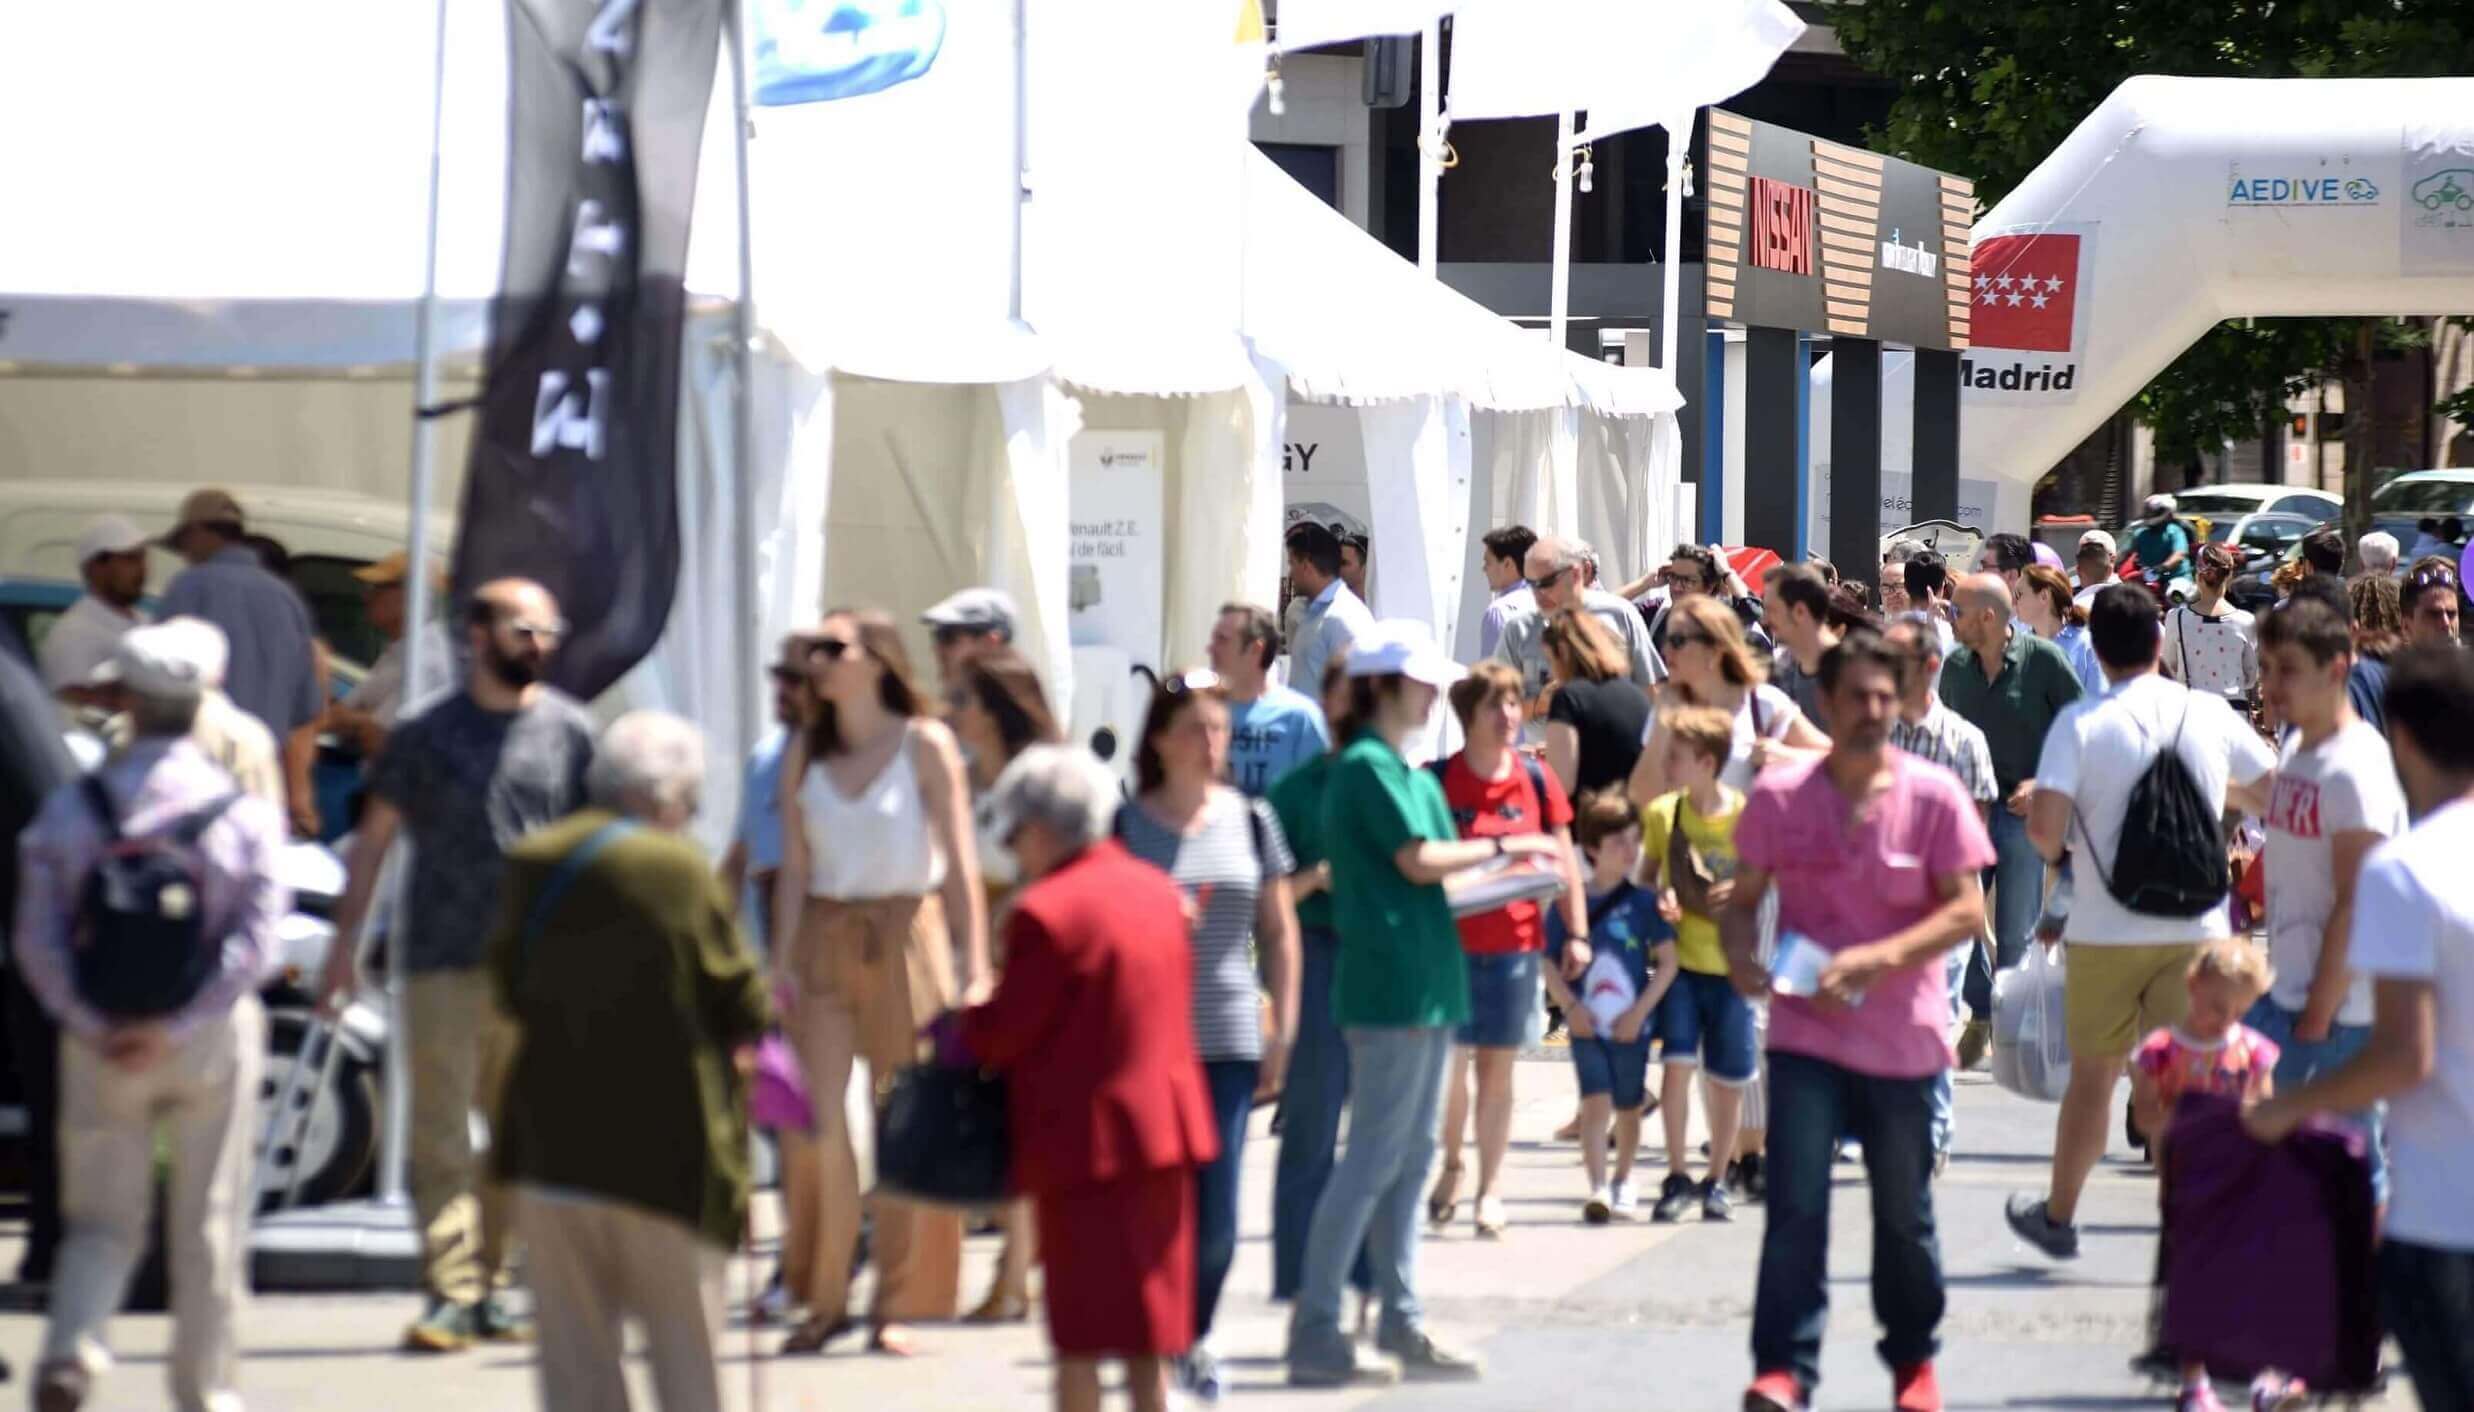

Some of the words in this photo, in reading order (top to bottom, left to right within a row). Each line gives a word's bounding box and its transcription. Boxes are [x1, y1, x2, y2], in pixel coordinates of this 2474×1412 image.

[2231, 179, 2339, 201] AEDIVE
[1751, 176, 1813, 276] NISSAN
[1070, 519, 1112, 537] enault
